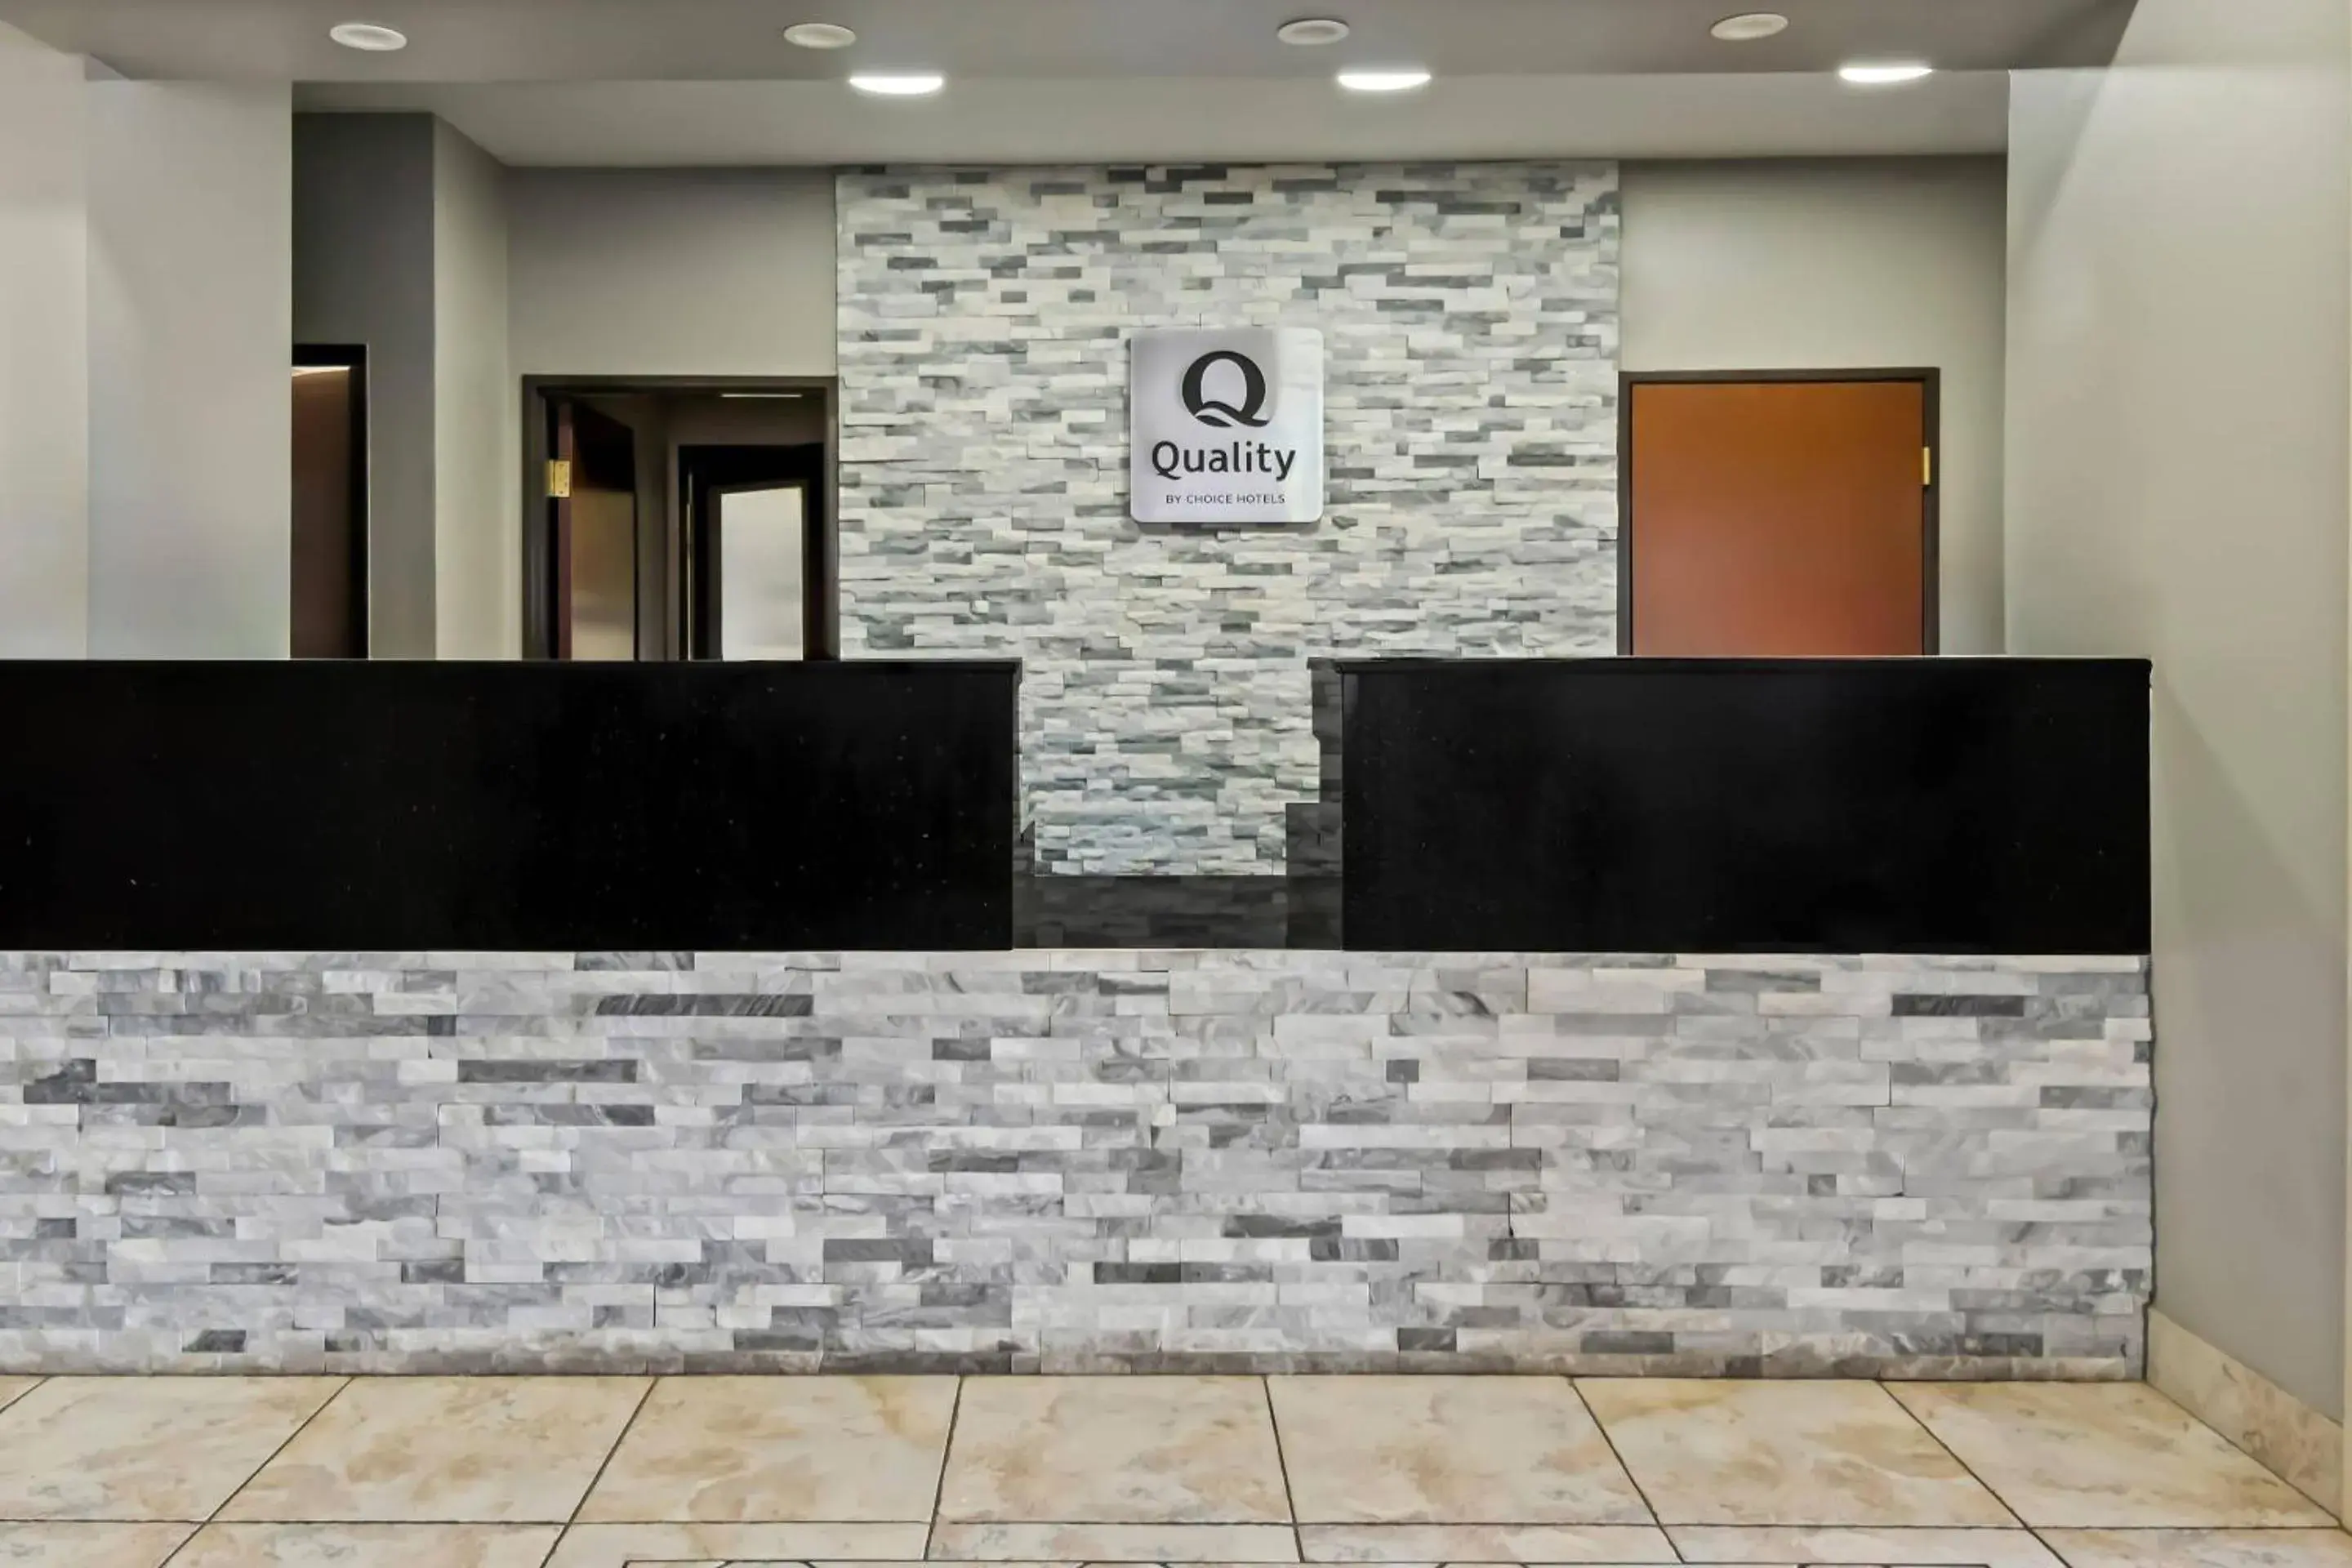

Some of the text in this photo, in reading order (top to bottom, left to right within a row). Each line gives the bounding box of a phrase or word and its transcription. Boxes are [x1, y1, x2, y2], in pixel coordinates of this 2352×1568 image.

[1183, 350, 1270, 428] Q
[1152, 440, 1296, 482] Quality
[1166, 494, 1285, 505] BY CHOICE HOTELS
